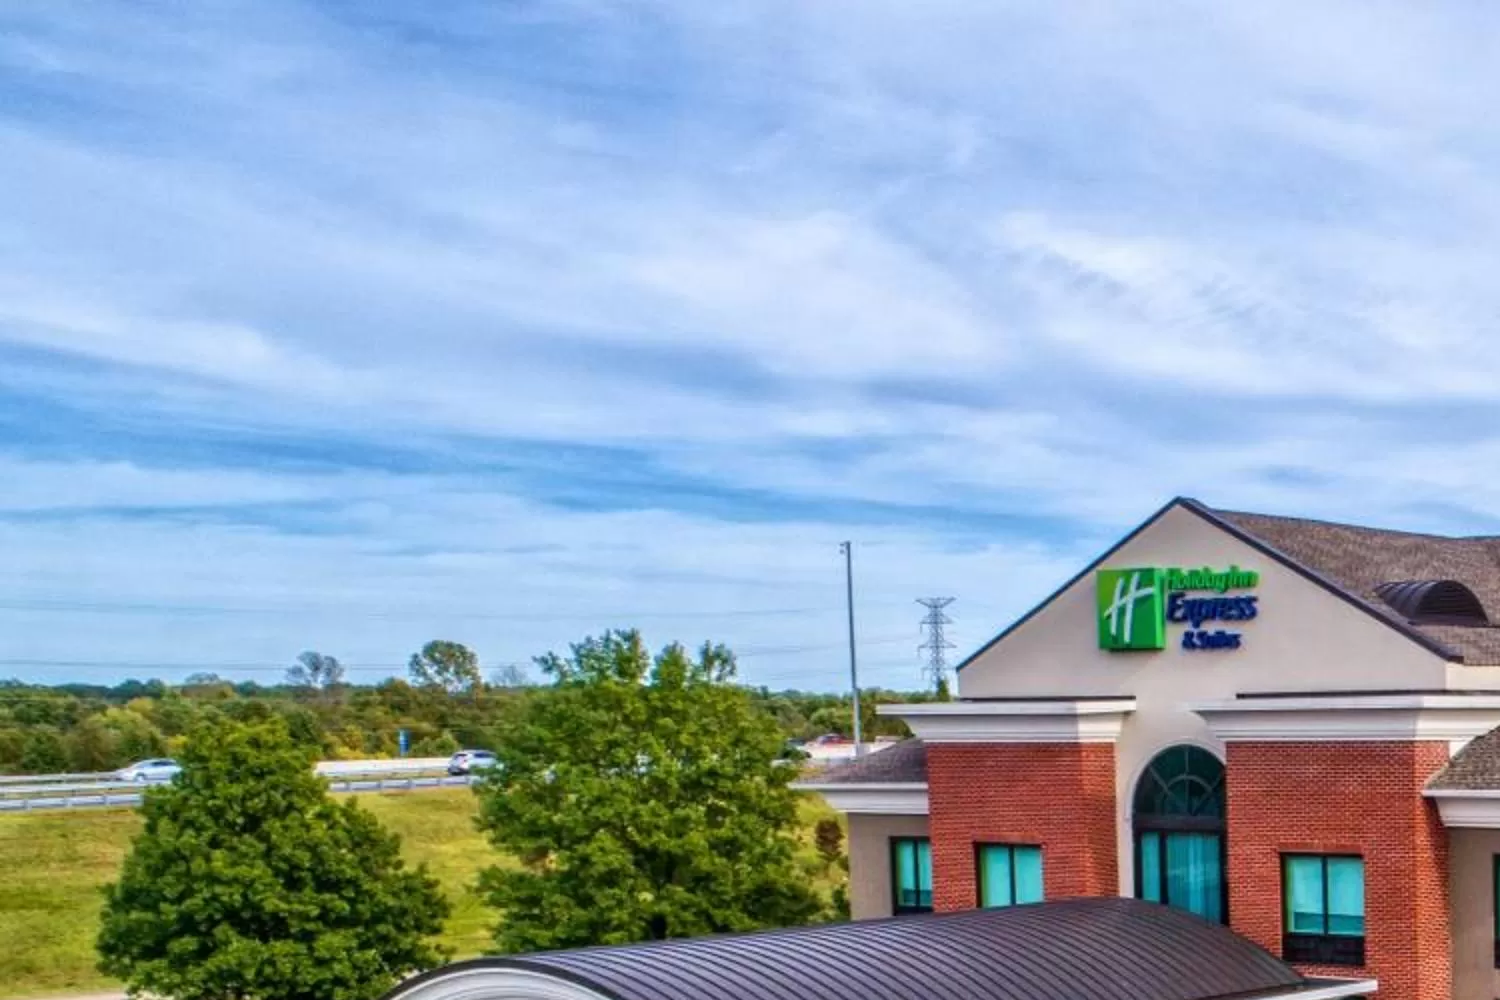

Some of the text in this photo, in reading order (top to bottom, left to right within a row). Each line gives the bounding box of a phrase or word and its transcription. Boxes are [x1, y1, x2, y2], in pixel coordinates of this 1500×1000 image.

[1167, 565, 1258, 593] Holiday Inn
[1167, 592, 1258, 628] Express
[1196, 630, 1242, 648] Suites
